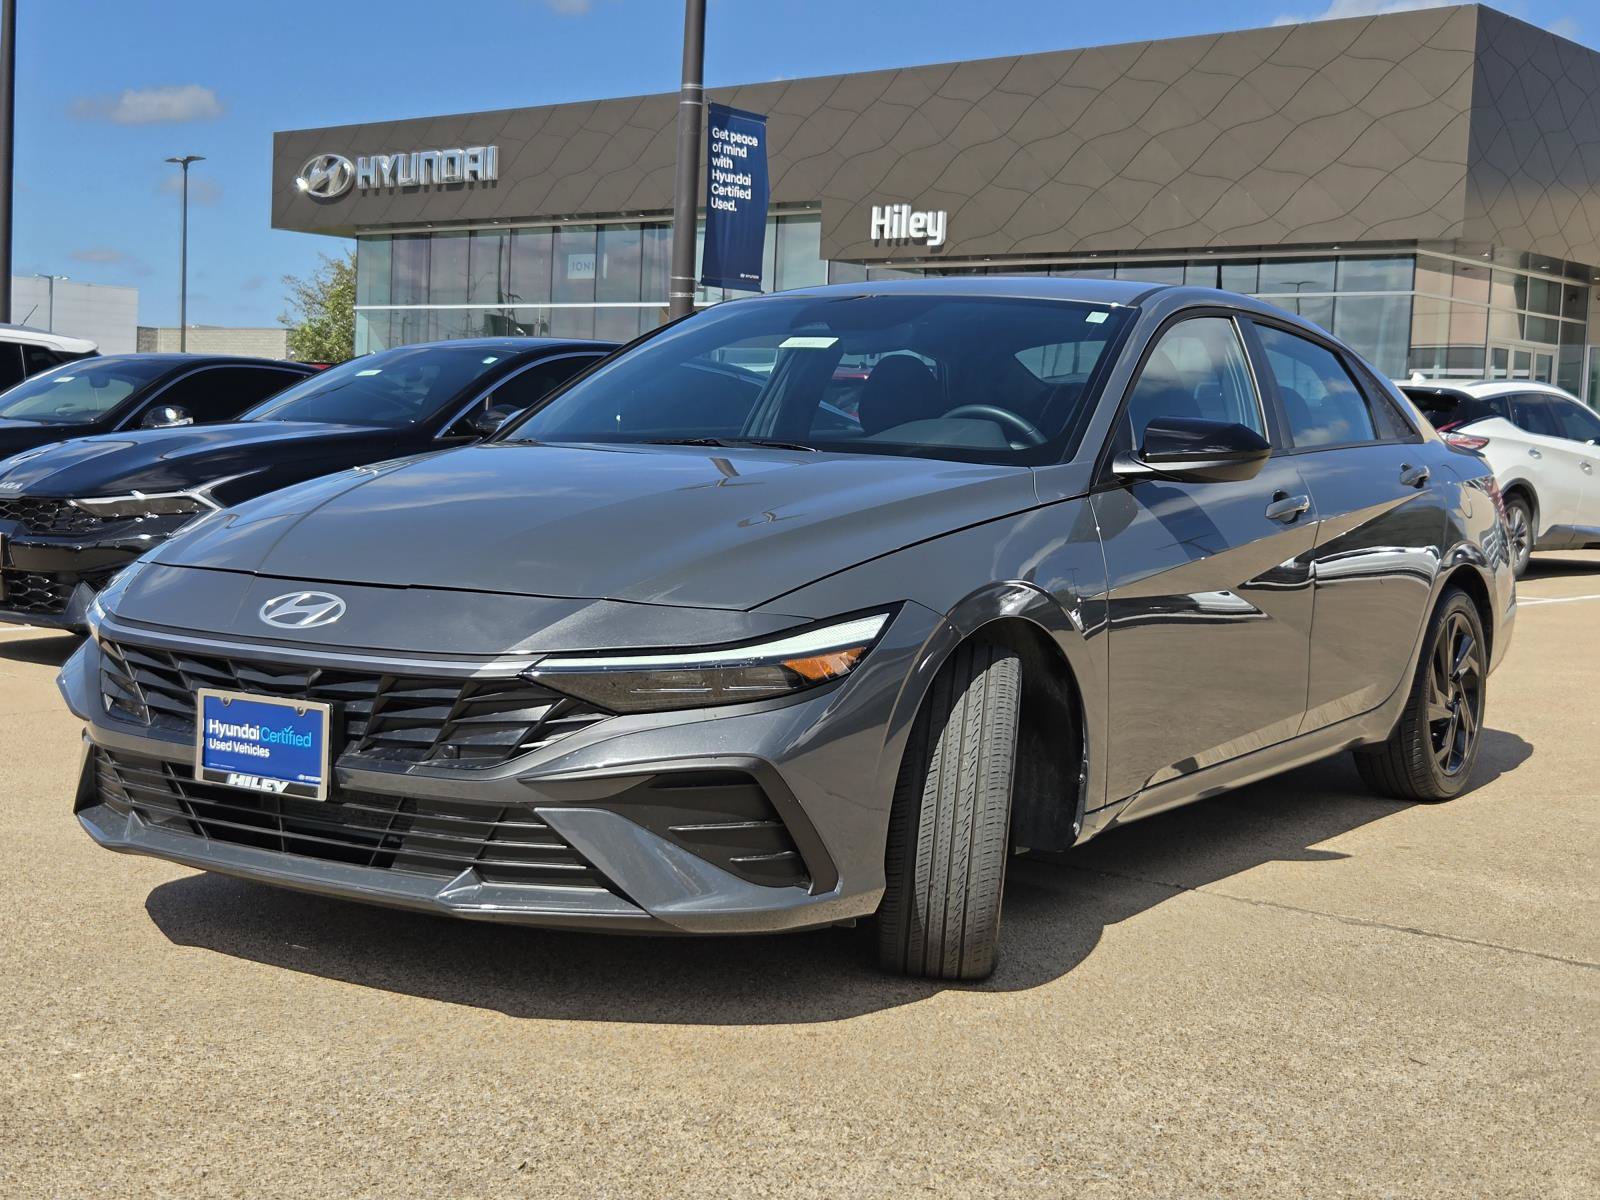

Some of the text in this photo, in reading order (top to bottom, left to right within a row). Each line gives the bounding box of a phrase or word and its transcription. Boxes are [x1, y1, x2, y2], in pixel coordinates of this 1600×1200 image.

[712, 127, 758, 147] Get peace
[712, 142, 747, 158] of mind
[357, 145, 499, 190] HYUNDAI
[712, 156, 733, 169] with
[712, 169, 751, 186] Hyundai
[711, 183, 751, 200] Certified
[711, 197, 737, 211] Used.
[871, 203, 947, 246] Hiley
[208, 719, 312, 747] Hyundai Certified
[208, 738, 270, 758] Used Vehicles
[226, 773, 290, 794] HILEY
